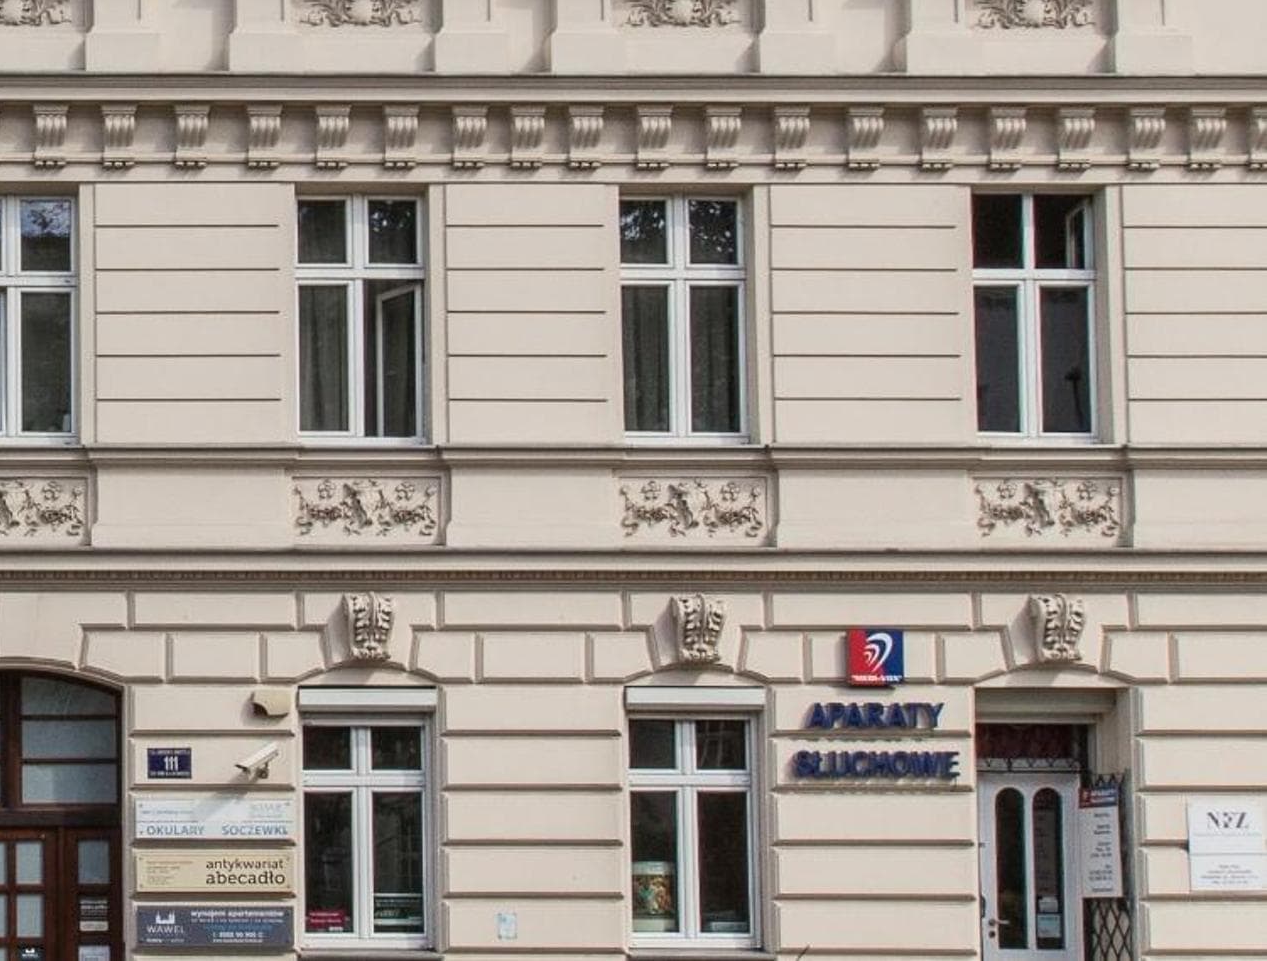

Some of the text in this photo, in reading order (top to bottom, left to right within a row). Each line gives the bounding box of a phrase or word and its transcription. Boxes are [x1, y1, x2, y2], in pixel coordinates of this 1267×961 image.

[808, 702, 945, 728] APARATY
[163, 756, 179, 771] 111
[795, 750, 961, 779] SŁUCHOWE
[146, 825, 205, 836] OKULARY
[206, 858, 284, 872] antykwariat
[206, 871, 285, 885] abecadło
